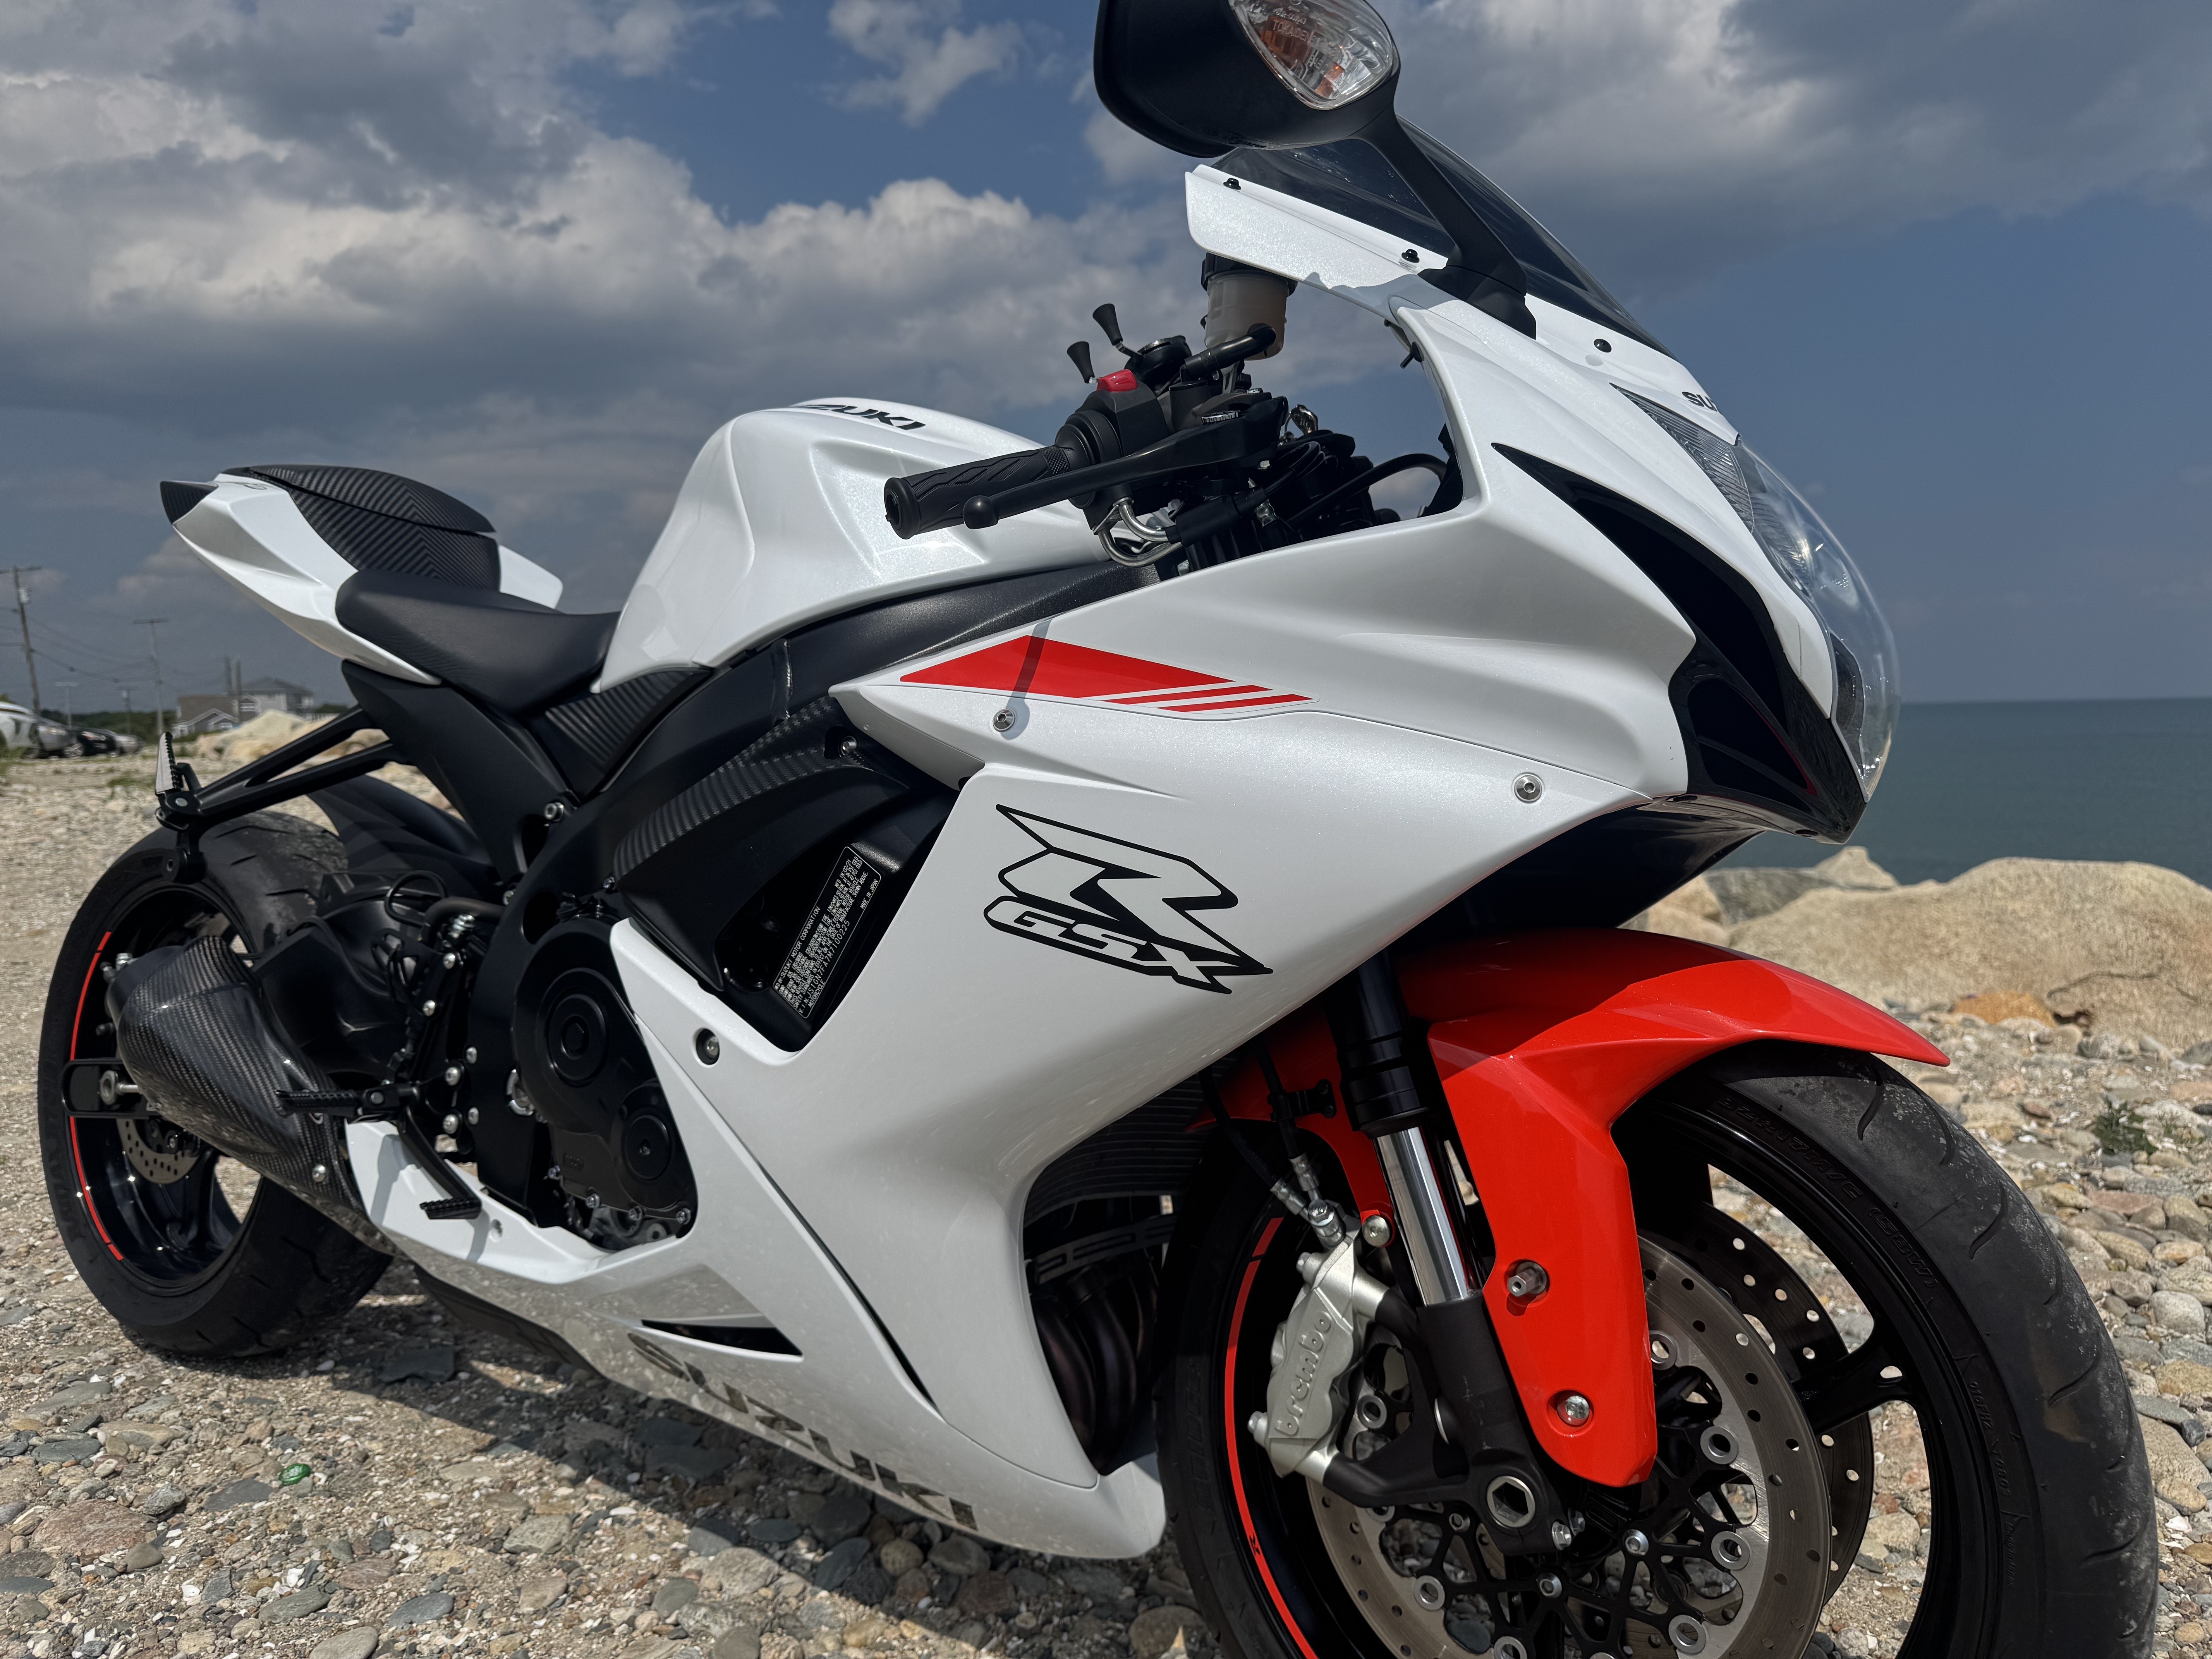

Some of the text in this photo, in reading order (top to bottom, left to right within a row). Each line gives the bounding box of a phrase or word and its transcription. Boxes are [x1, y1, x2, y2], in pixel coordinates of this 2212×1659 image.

[791, 941, 802, 958] MOTOR
[800, 906, 821, 941] CORPORATION
[795, 977, 806, 994] VEHICLE
[842, 893, 851, 907] MOTOR
[848, 876, 859, 894] VEHICLE
[815, 953, 825, 968] EFFECT
[830, 927, 838, 939] DATE
[839, 896, 855, 923] MANUFACTURE
[852, 884, 862, 897] SHOWN
[860, 898, 868, 909] MADE
[870, 879, 879, 893] JAPAN
[807, 979, 825, 1008] MOTORCYCLE
[1274, 1310, 1332, 1436] brembo
[627, 1333, 979, 1530] SUZUKI
